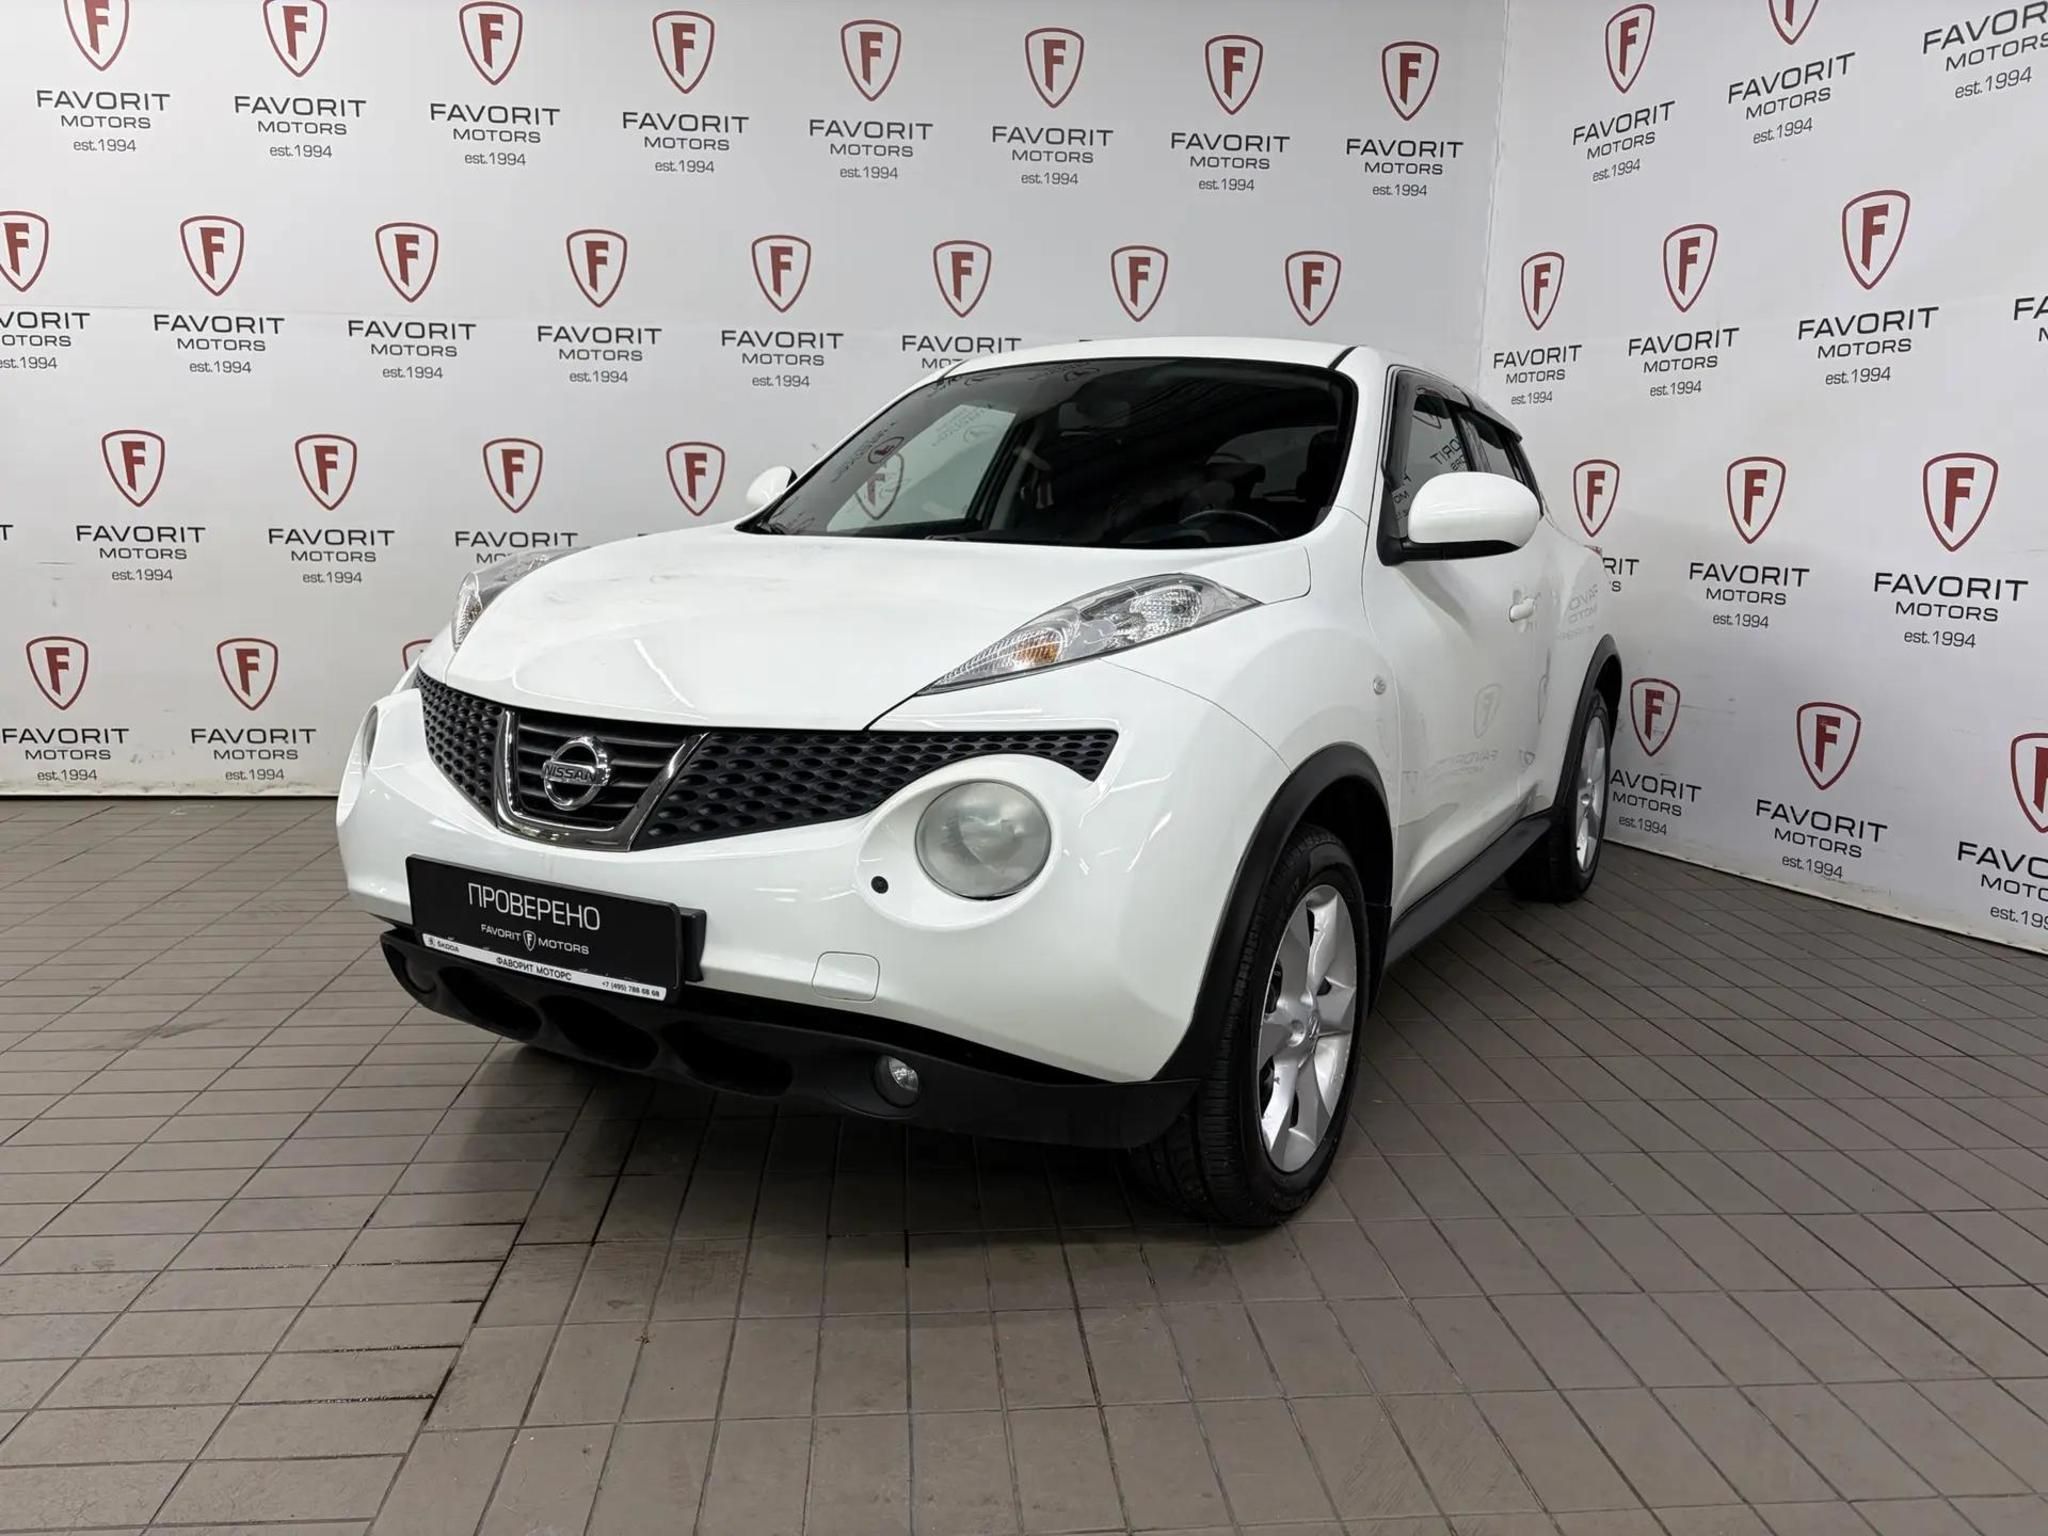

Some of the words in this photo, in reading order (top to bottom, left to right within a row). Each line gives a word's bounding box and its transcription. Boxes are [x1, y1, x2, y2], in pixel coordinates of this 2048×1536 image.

[1728, 52, 1855, 108] FAVORIT
[1955, 66, 2032, 98] est.1994
[37, 90, 170, 111] FAVORIT
[235, 96, 366, 117] FAVORIT
[1746, 87, 1830, 120] MOTORS
[61, 115, 151, 129] MOTORS
[431, 103, 560, 126] FAVORIT
[623, 112, 749, 133] FAVORIT
[258, 121, 347, 135] MOTORS
[810, 119, 933, 140] FAVORIT
[1573, 101, 1675, 150] FAVORIT
[1753, 117, 1812, 144] est.1994
[453, 128, 541, 143] MOTORS
[645, 136, 729, 150] MOTORS
[993, 126, 1113, 146] FAVORIT
[1171, 132, 1290, 152] FAVORIT
[73, 139, 136, 152] est.1994
[270, 145, 332, 158] est.1994
[831, 144, 913, 157] MOTORS
[1347, 139, 1464, 158] FAVORIT
[1587, 132, 1655, 159] MOTORS
[465, 152, 526, 166] est.1994
[1012, 150, 1093, 163] MOTORS
[1190, 156, 1270, 169] MOTORS
[655, 160, 714, 173] est.1994
[840, 166, 898, 179] est.1994
[1365, 162, 1442, 175] MOTORS
[1593, 158, 1640, 182] est.1994
[1021, 172, 1078, 185] est.1994
[1199, 178, 1255, 191] est.1994
[1373, 184, 1427, 196] est.1994
[154, 314, 285, 334] FAVORIT
[348, 320, 476, 340] FAVORIT
[1798, 307, 1939, 340] FAVORIT
[538, 326, 662, 344] FAVORIT
[722, 330, 844, 349] FAVORIT
[1629, 328, 1739, 356] FAVORIT
[177, 338, 265, 351] MOTORS
[371, 344, 457, 357] MOTORS
[902, 335, 1021, 353] FAVORIT
[1818, 338, 1911, 359] MOTORS
[559, 349, 642, 361] MOTORS
[742, 353, 824, 366] MOTORS
[1494, 344, 1582, 368] FAVORIT
[189, 361, 251, 373] est.1994
[383, 366, 443, 379] est.1994
[1644, 355, 1717, 373] MOTORS
[569, 370, 628, 383] est.1994
[752, 375, 810, 387] est.1994
[1506, 369, 1565, 384] MOTORS
[1825, 367, 1891, 385] est.1994
[1650, 380, 1701, 396] est.1994
[1511, 391, 1552, 405] est.1994
[76, 525, 206, 543] FAVORIT
[269, 528, 395, 546] FAVORIT
[455, 531, 578, 548] FAVORIT
[100, 548, 187, 559] MOTORS
[291, 551, 376, 562] MOTORS
[112, 569, 173, 581] est.1994
[303, 572, 362, 583] est.1994
[1690, 562, 1810, 587] FAVORIT
[1874, 572, 2028, 601] FAVORIT
[1706, 588, 1786, 605] MOTORS
[1896, 601, 1998, 622] MOTORS
[1713, 613, 1768, 628] est.1994
[1904, 631, 1976, 648] est.1994
[2, 728, 129, 744] FAVORIT
[191, 729, 316, 744] FAVORIT
[25, 750, 111, 760] MOTORS
[214, 749, 298, 760] MOTORS
[37, 769, 97, 780] est.1994
[226, 769, 284, 780] est.1994
[545, 765, 595, 782] NISSAN
[1613, 792, 1681, 816] MOTORS
[1619, 817, 1666, 835] est.1994
[1756, 799, 1888, 847] FAVORIT
[1775, 828, 1861, 858] MOTORS
[1782, 856, 1842, 880] est.1994
[467, 882, 600, 931] ПРОВЕРЕНО
[481, 924, 521, 941] FAVORIT
[538, 937, 589, 955] MOTORS
[496, 956, 533, 973] ФАВОРИТ
[536, 964, 572, 981] МОТОРС
